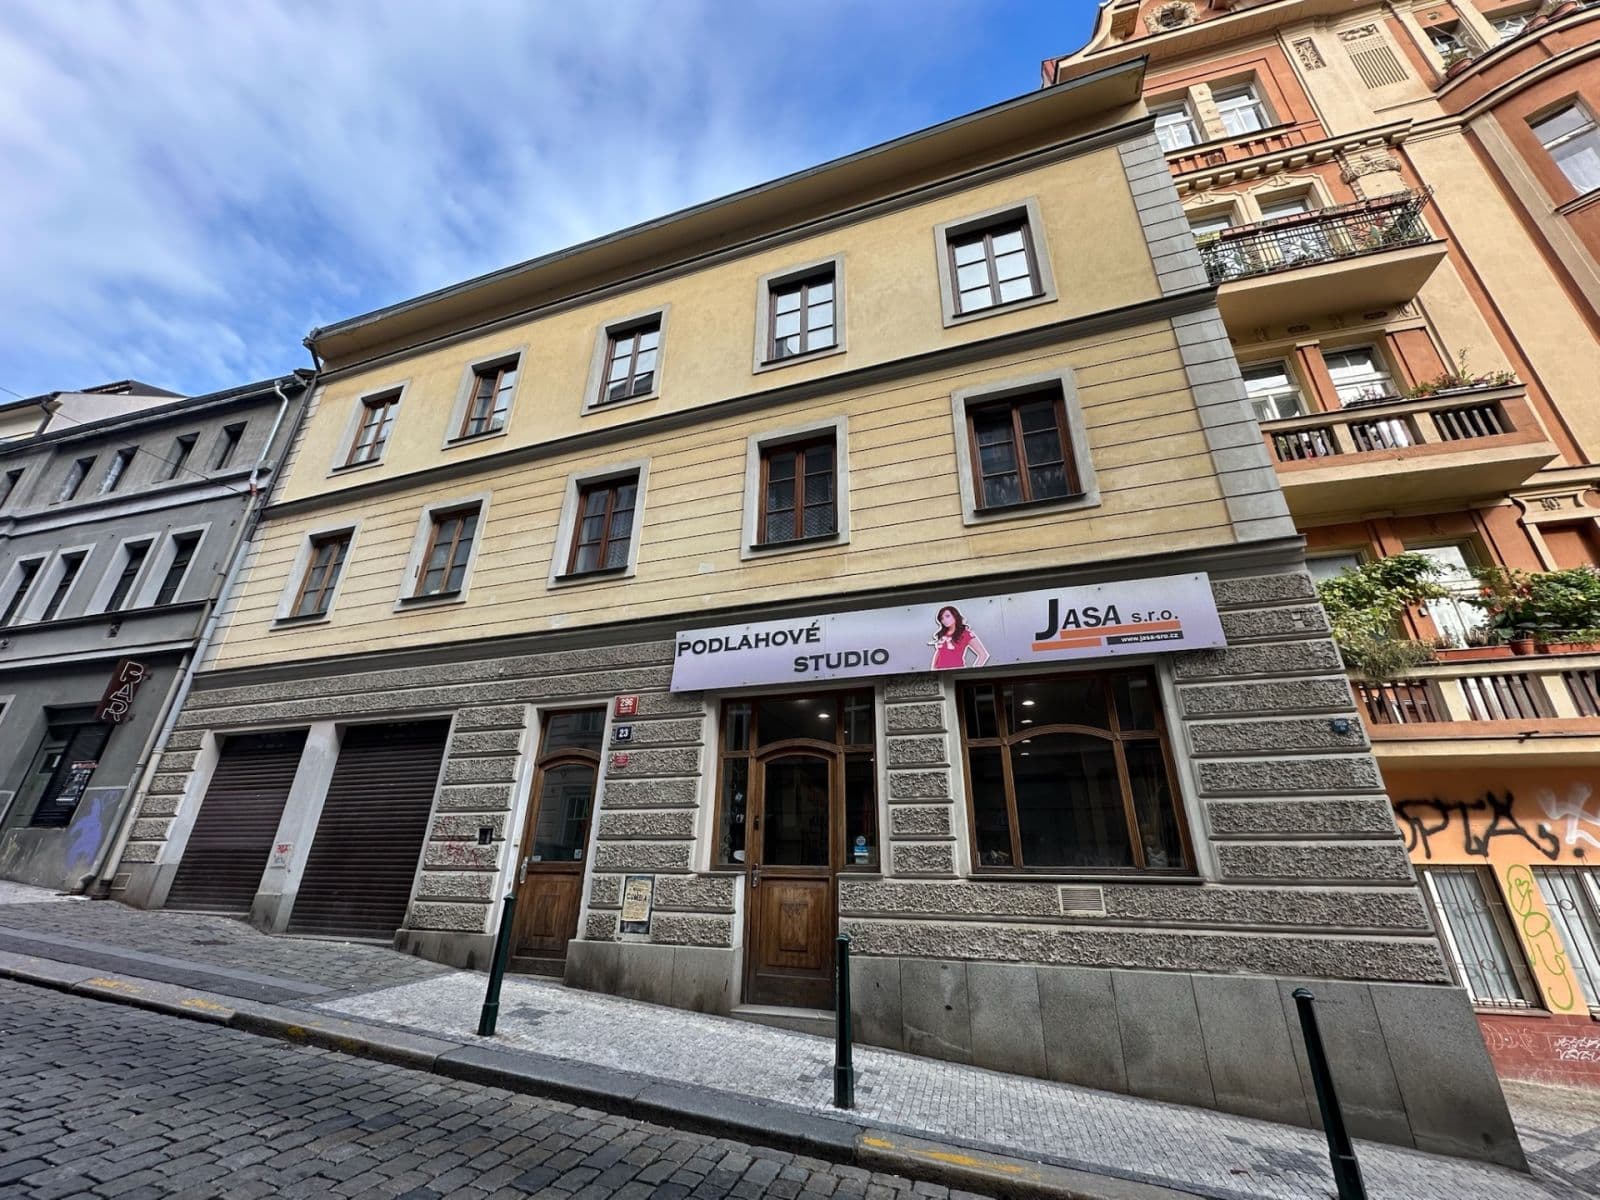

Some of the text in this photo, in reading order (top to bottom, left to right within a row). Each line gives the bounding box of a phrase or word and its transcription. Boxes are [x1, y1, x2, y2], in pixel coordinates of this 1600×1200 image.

[1131, 609, 1179, 623] s.r.o.
[677, 622, 821, 657] PODLAHOVÉ
[794, 648, 889, 673] STUDIO
[101, 661, 144, 722] BAR
[618, 728, 629, 738] 23
